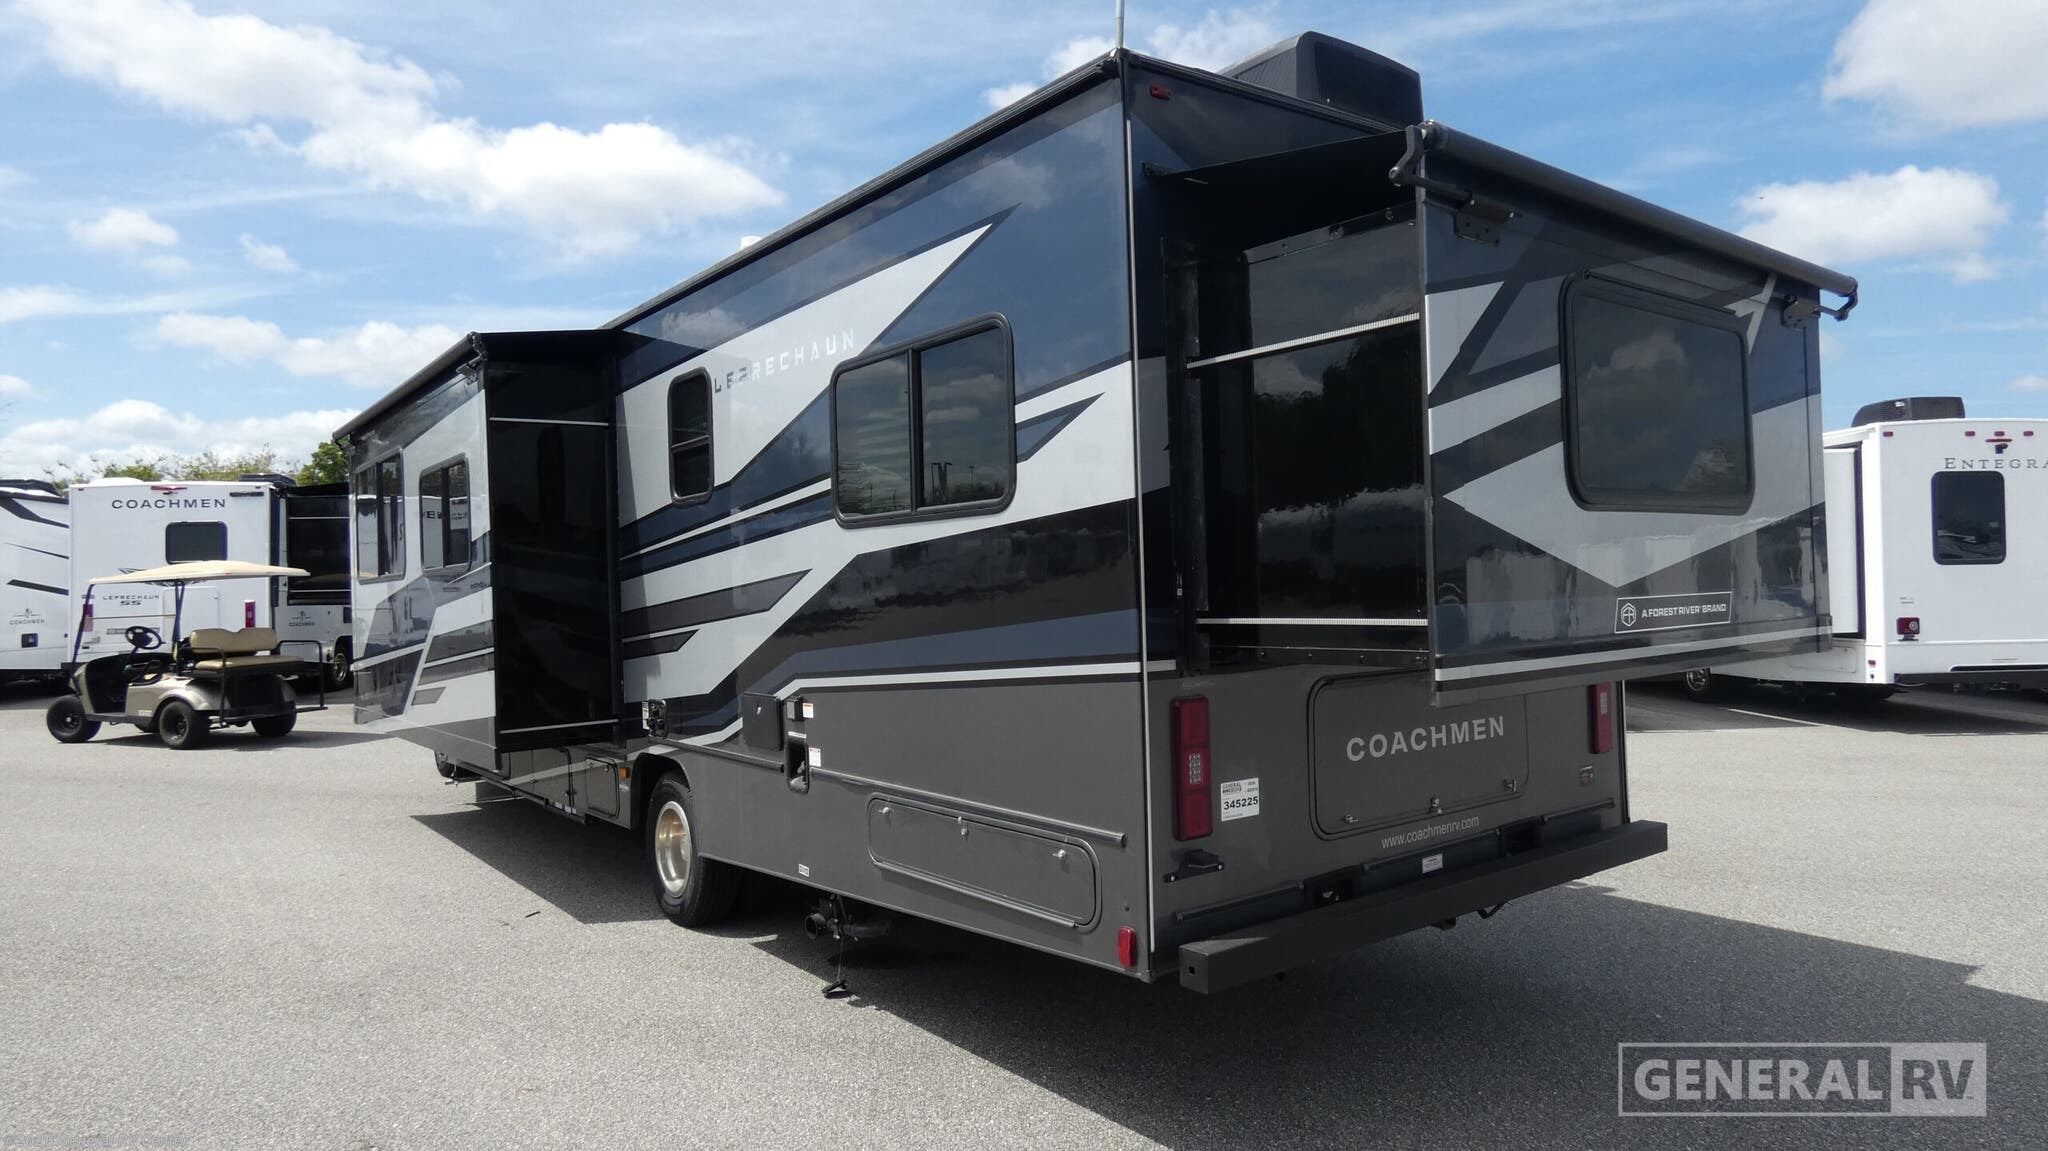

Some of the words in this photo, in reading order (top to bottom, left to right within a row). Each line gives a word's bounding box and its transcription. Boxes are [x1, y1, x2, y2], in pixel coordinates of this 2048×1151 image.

[714, 328, 855, 393] LEPRECHAUN
[111, 499, 226, 509] COACHMEN
[1641, 609, 1648, 618] A
[1649, 607, 1677, 617] FOREST
[1678, 605, 1699, 615] RIVER
[1702, 603, 1727, 613] BRAND
[1346, 716, 1504, 761] COACHMEN
[1224, 796, 1258, 810] 345225
[1382, 816, 1480, 848] www.coachmenrv.com
